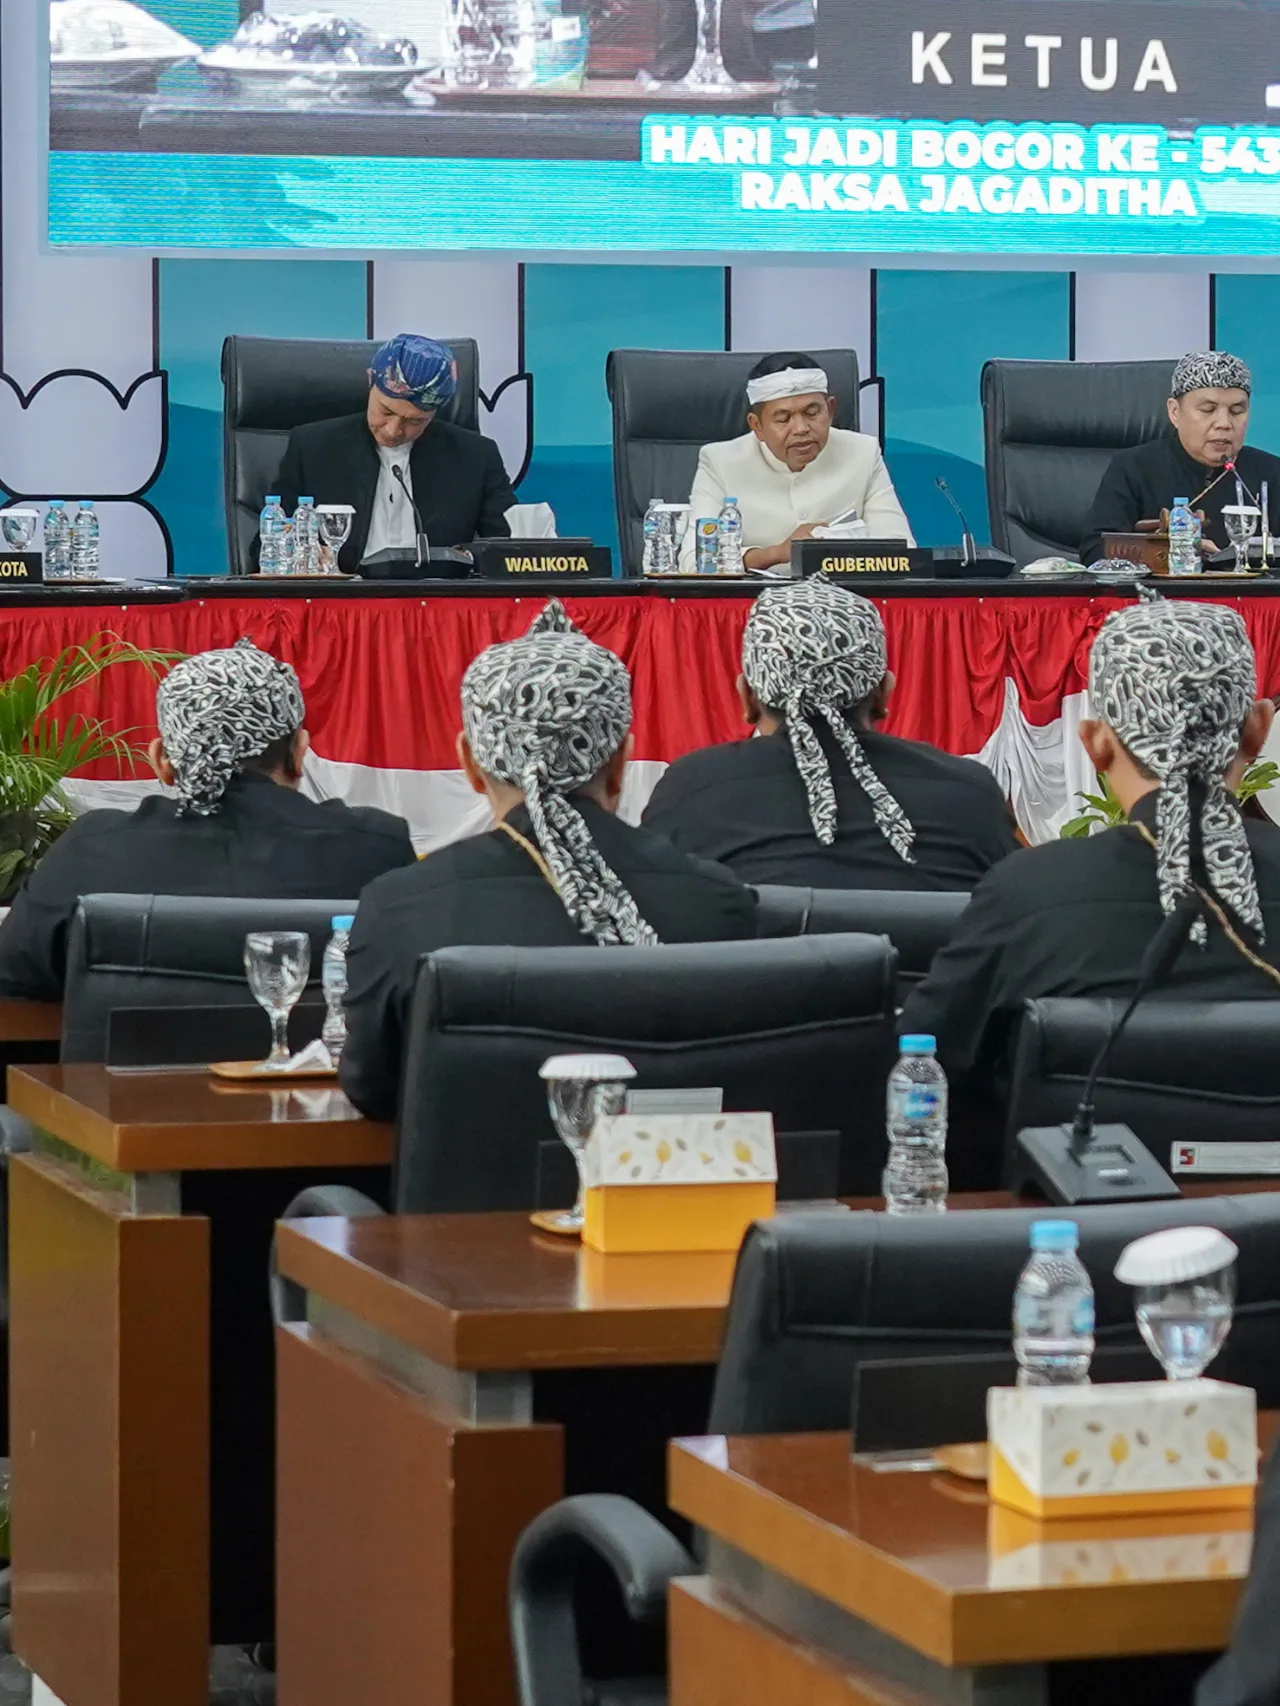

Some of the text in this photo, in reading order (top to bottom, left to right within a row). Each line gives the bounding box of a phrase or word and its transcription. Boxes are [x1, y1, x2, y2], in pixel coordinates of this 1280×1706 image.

[910, 30, 1179, 93] KETUA
[650, 125, 771, 166] HARI
[783, 128, 898, 168] JADI
[911, 131, 1085, 172] BOGOR
[1098, 134, 1158, 172] KE
[740, 172, 1198, 217] RAKSA JAGADITHA
[0, 561, 29, 577] OTA
[505, 555, 589, 573] WALIKOTA
[822, 555, 910, 574] GUBERNUR
